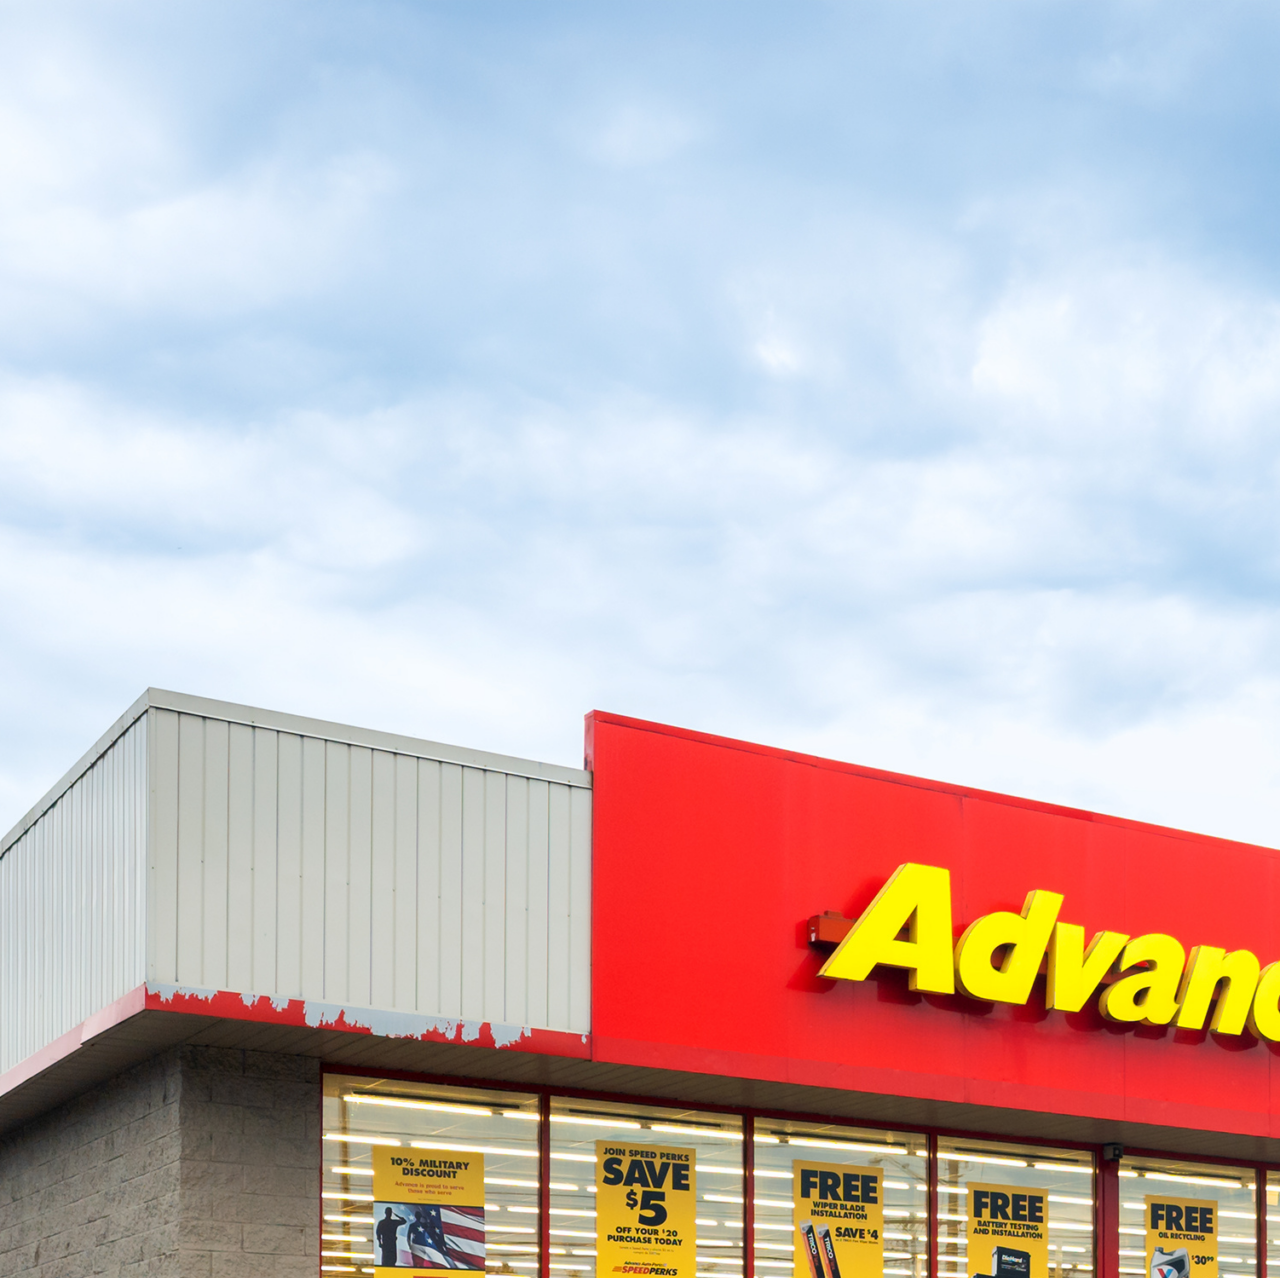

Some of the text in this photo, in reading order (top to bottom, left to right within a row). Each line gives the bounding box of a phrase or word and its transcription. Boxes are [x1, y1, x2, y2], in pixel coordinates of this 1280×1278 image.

[603, 1147, 689, 1162] JOIN SPEED PERKS
[390, 1157, 470, 1170] 10% MILITARY
[402, 1167, 458, 1179] DISCOUNT
[602, 1157, 690, 1191] SAVE
[801, 1169, 878, 1204] FREE
[625, 1189, 668, 1227] $5
[813, 1201, 865, 1212] WIPER BLADE
[973, 1190, 1044, 1223] FREE
[811, 1209, 867, 1220] INSTALLATION
[1151, 1203, 1214, 1234] FREE
[616, 1226, 632, 1234] OFF
[635, 1228, 659, 1236] YOUR
[977, 1220, 1039, 1232] BATTERY TESTING
[835, 1227, 879, 1240] SAVE $4
[991, 1229, 1043, 1239] INSTALLATION
[1170, 1233, 1205, 1241] RECYCLING
[607, 1235, 683, 1246] PURCHASE TODAY
[808, 1232, 818, 1255] TRICO
[824, 1237, 834, 1259] TRICO
[1001, 1254, 1022, 1263] DieHard
[621, 1265, 678, 1276] SPEEDPERKS
